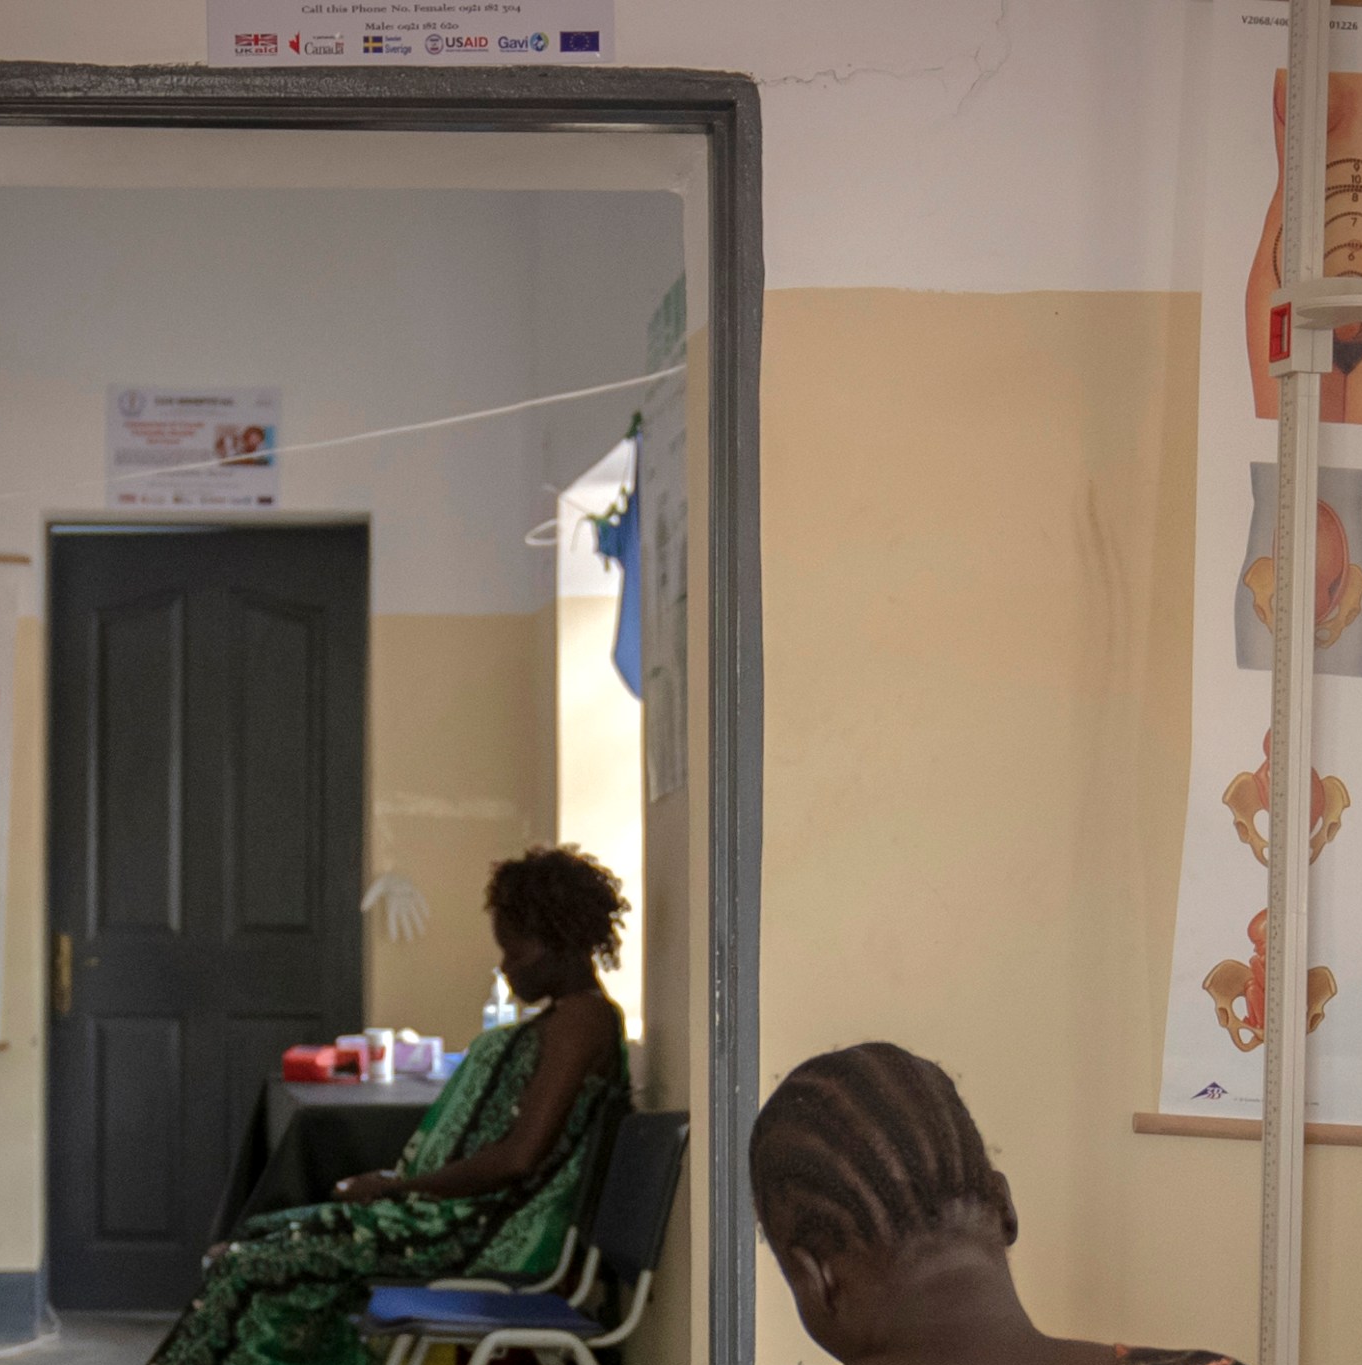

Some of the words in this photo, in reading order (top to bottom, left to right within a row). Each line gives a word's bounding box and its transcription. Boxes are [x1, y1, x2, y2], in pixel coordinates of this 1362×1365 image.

[301, 4, 323, 13] Call
[326, 4, 348, 13] this
[351, 4, 387, 13] Phone
[391, 4, 411, 13] No.
[414, 3, 456, 13] Female:
[365, 21, 394, 31] Male:
[1329, 20, 1358, 30] 01226
[445, 36, 489, 48] USAID
[498, 35, 529, 49] Gavi
[304, 42, 345, 55] Canada
[1351, 174, 1362, 184] 10
[1351, 192, 1359, 202] 8
[1350, 217, 1358, 227] 7
[1348, 252, 1356, 261] 6
